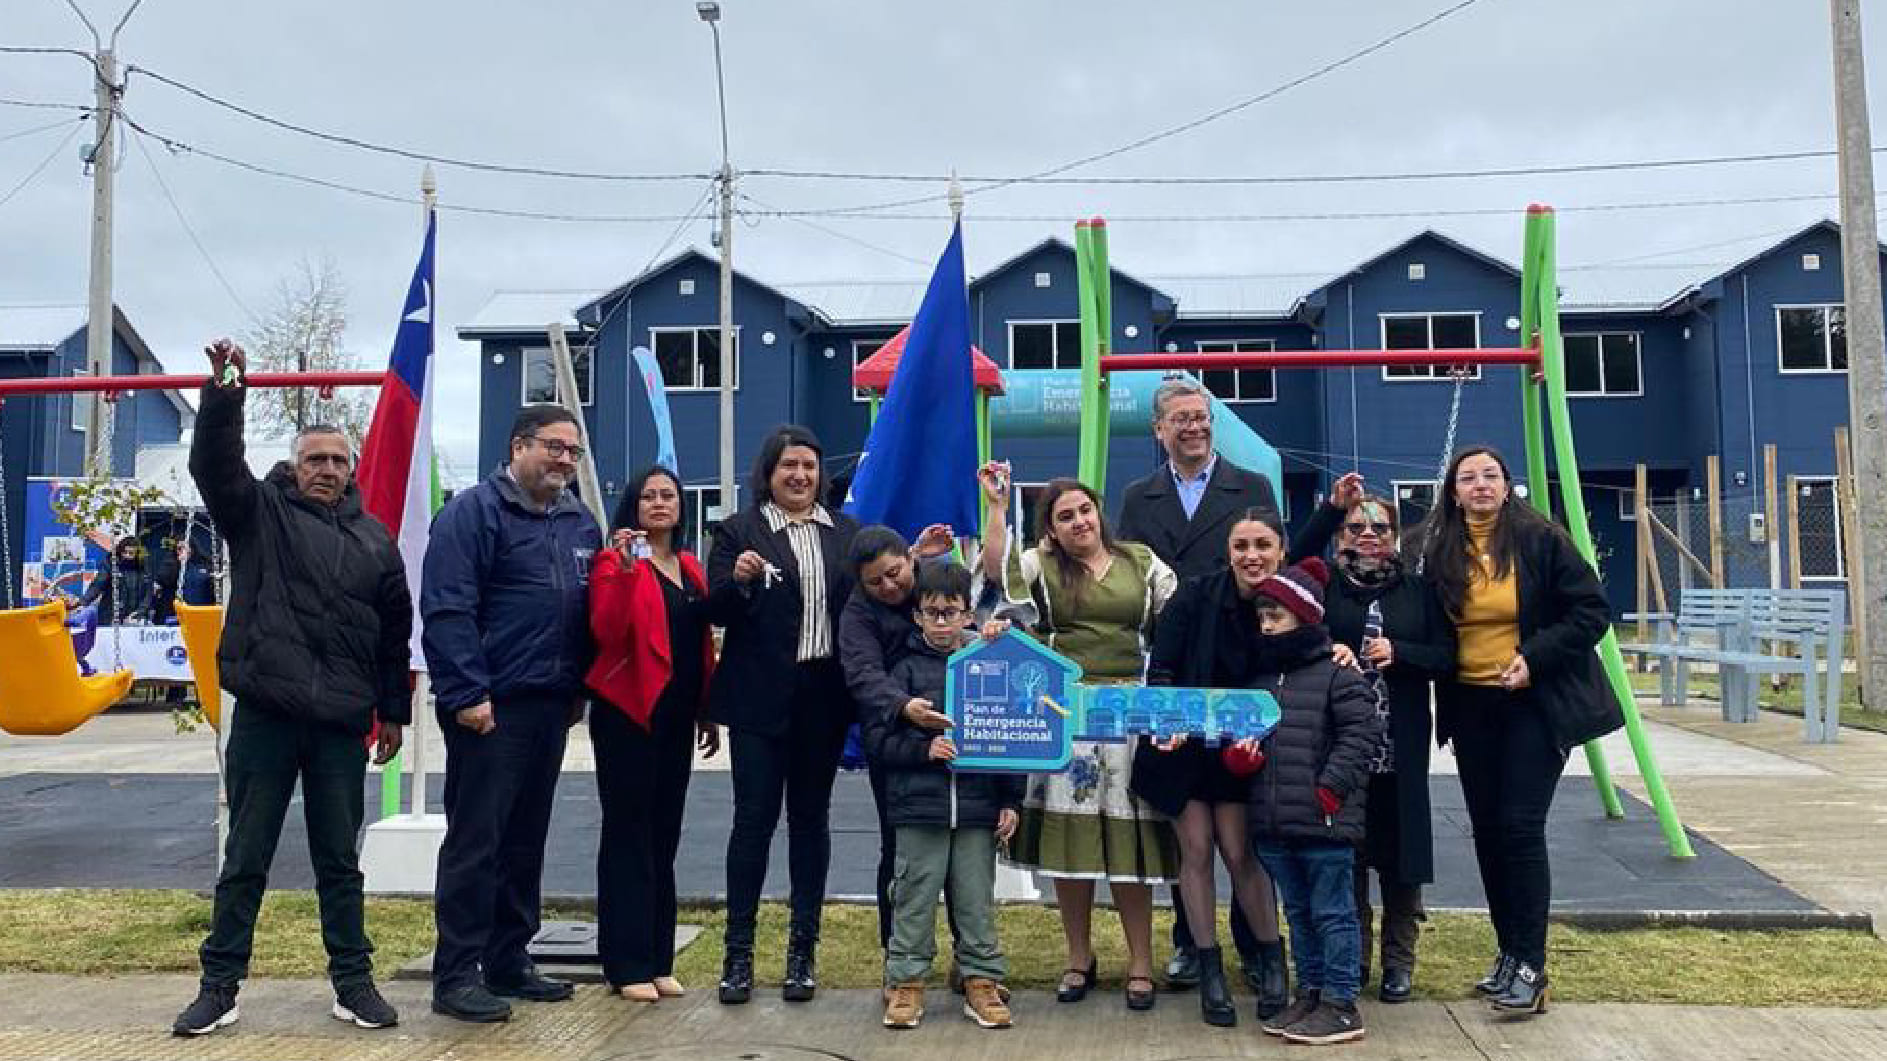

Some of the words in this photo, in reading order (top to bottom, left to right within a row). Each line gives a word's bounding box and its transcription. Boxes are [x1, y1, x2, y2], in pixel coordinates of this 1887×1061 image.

[963, 703, 988, 713] Plan
[963, 715, 1047, 729] Emergencia
[963, 728, 1053, 741] Habitacional
